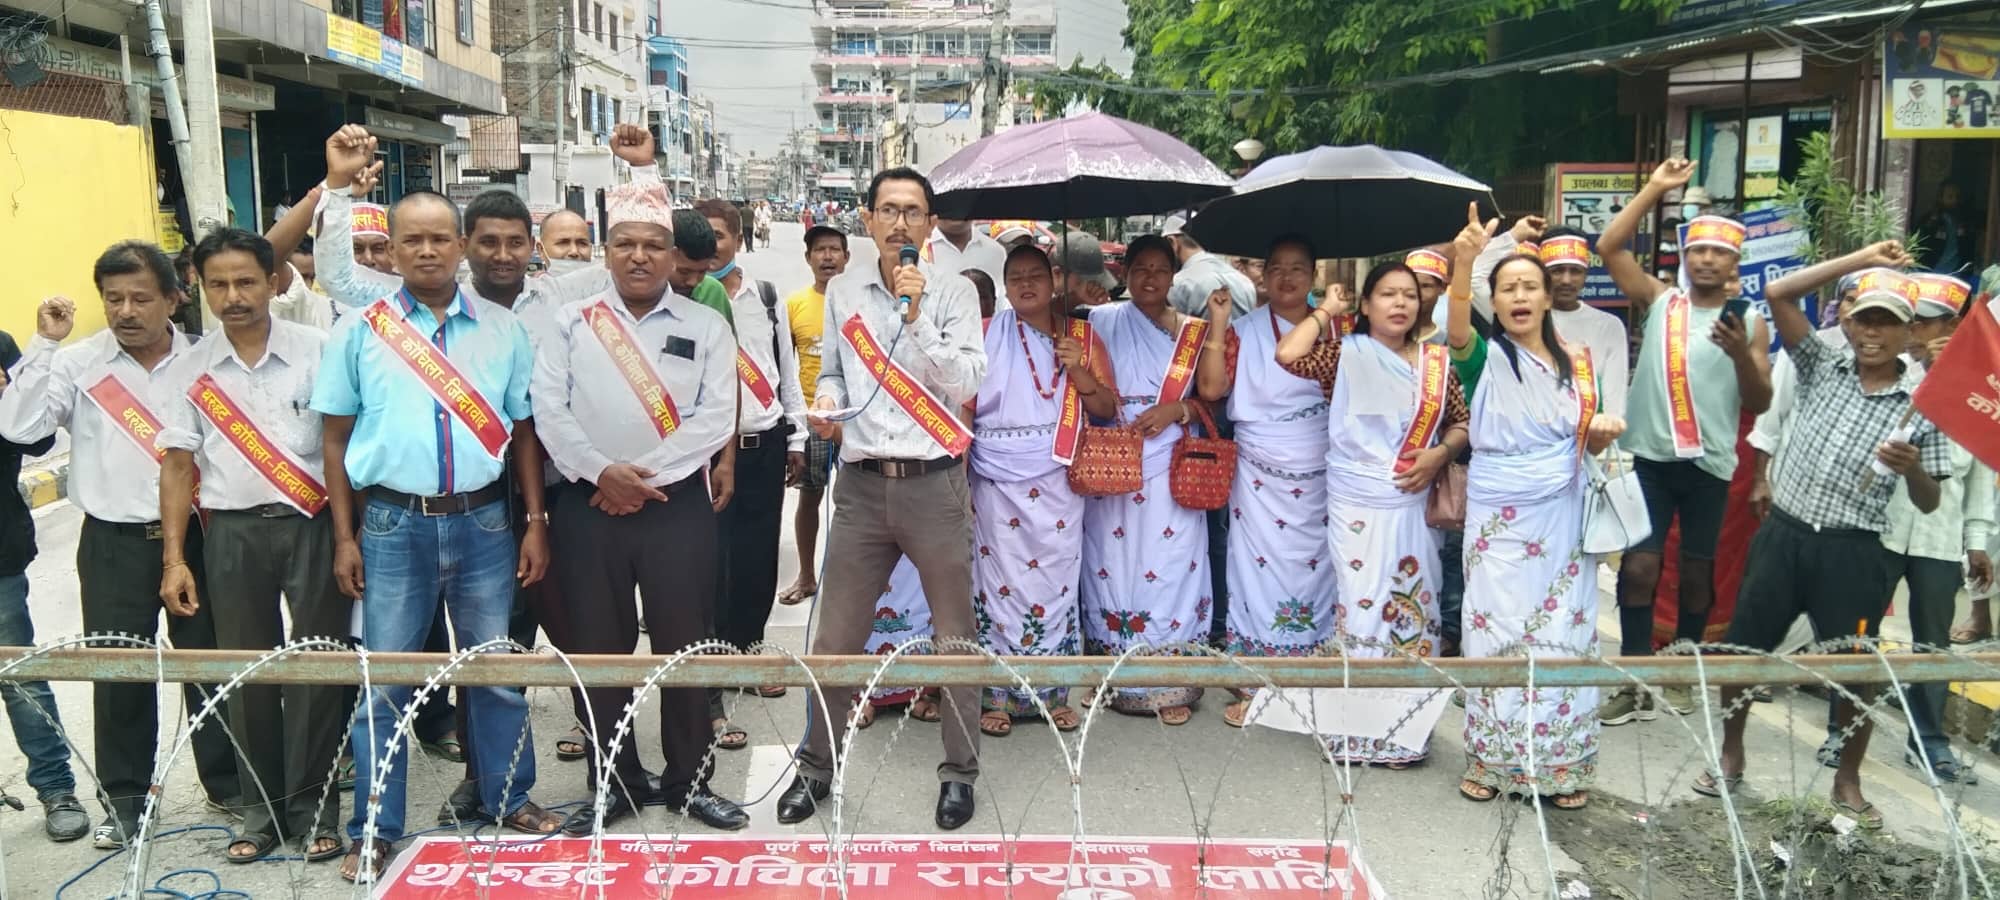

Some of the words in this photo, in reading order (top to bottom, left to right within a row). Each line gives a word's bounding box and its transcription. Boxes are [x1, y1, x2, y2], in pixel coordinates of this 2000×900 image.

[764, 840, 801, 857] पूर्ण
[927, 839, 1002, 854] निर्वाचन
[405, 861, 630, 888] थरुहट
[643, 853, 897, 888] कोचिला
[916, 855, 1173, 889] राज्यको
[1192, 858, 1356, 892] लागि
